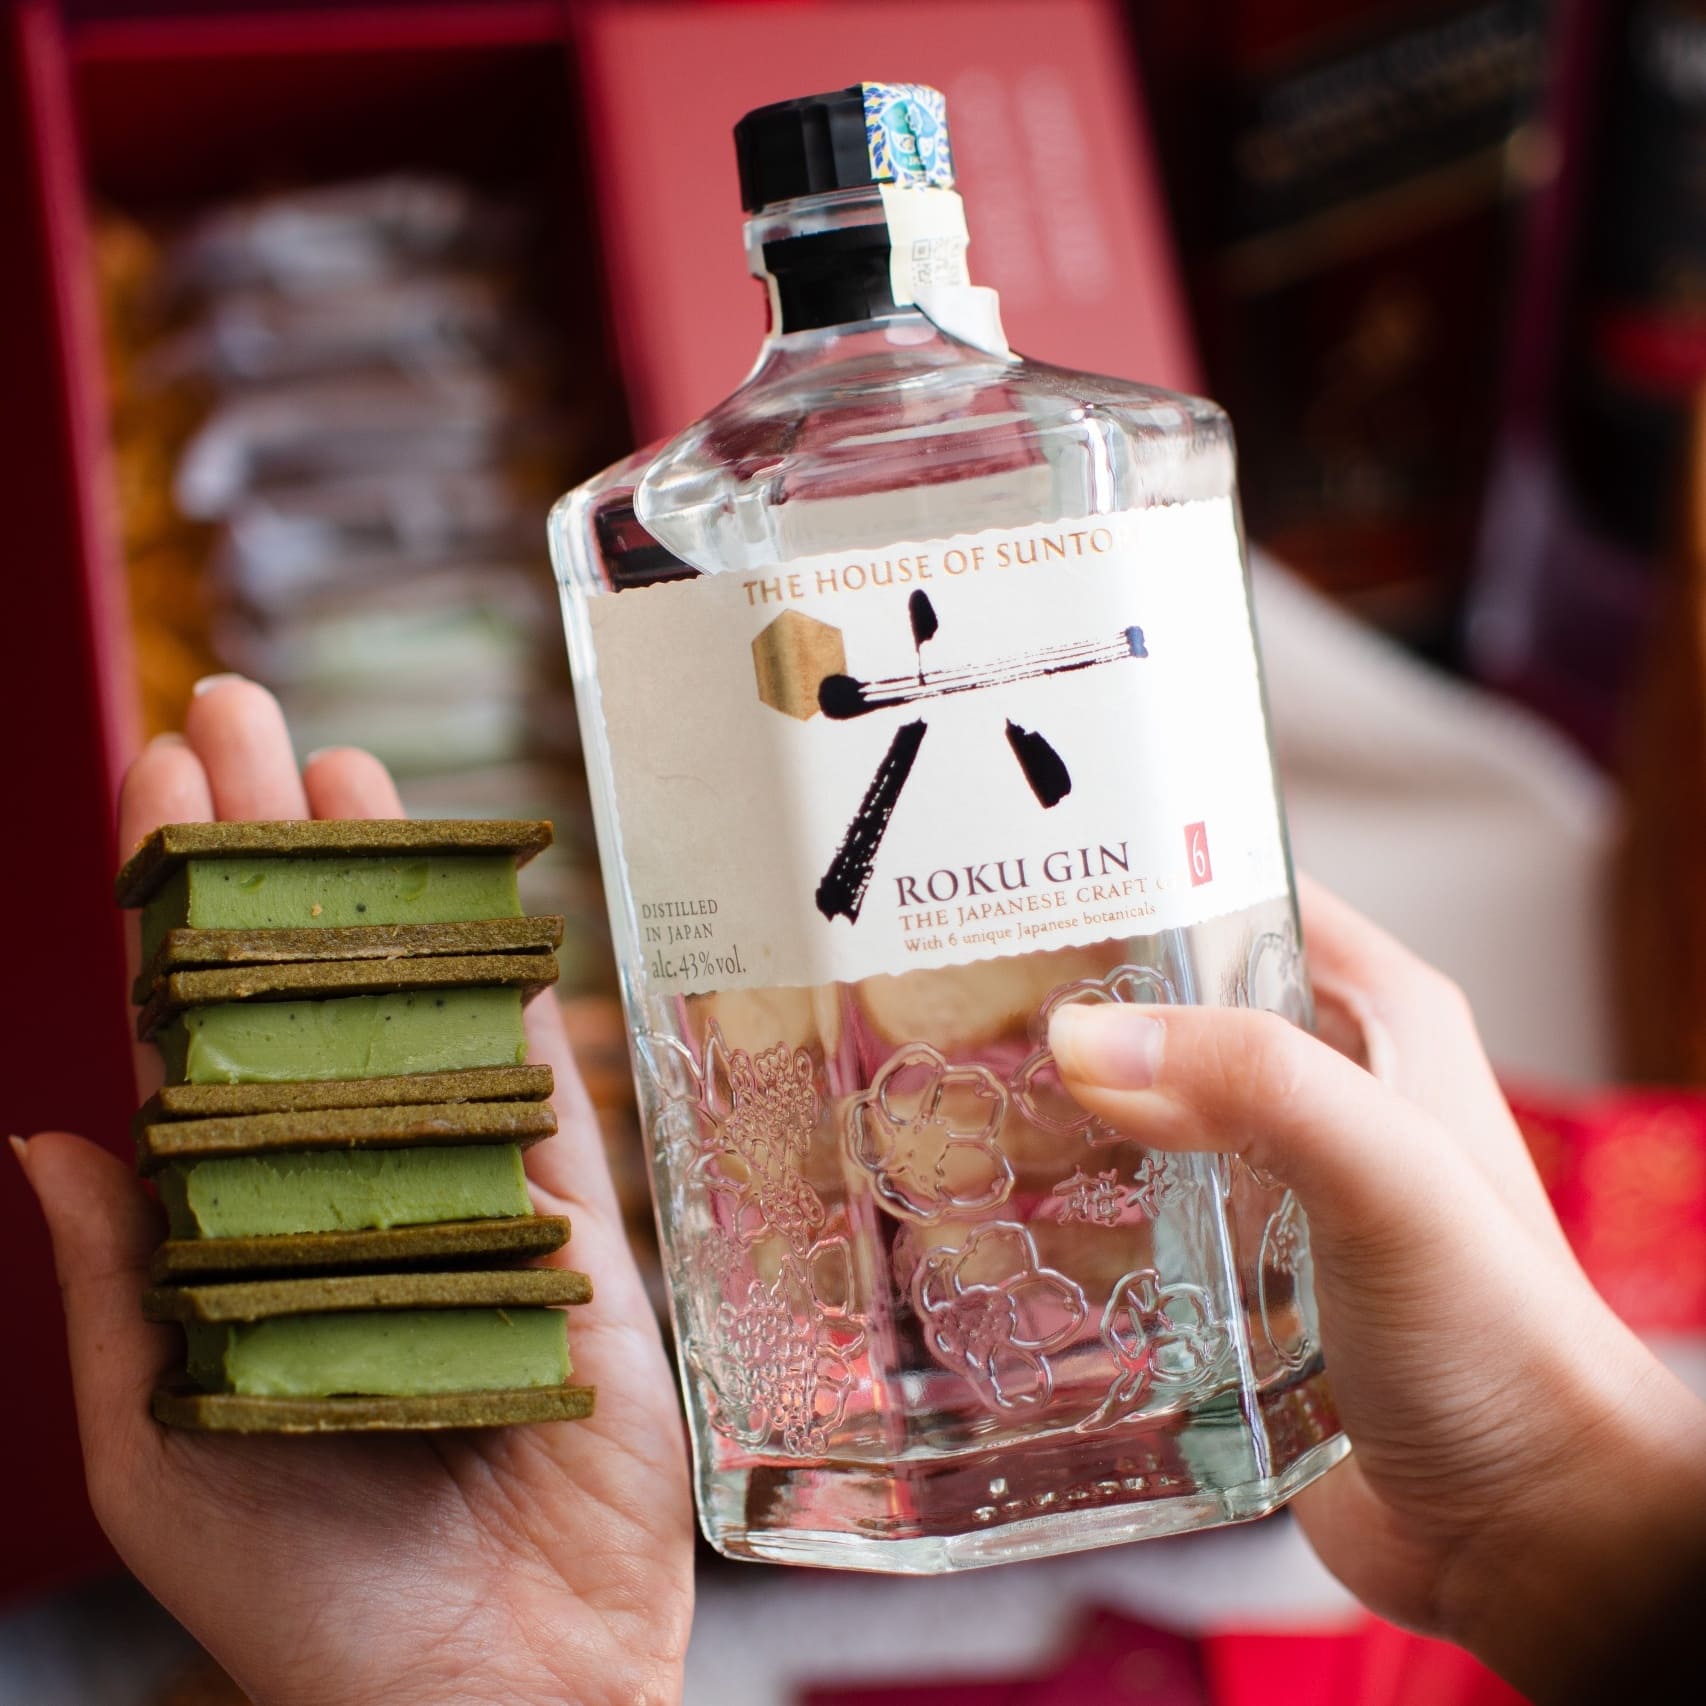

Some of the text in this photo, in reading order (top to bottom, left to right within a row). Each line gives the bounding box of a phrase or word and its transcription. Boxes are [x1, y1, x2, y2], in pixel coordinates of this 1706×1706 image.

[743, 527, 1122, 606] THE HOUSE OF SUNTO
[894, 841, 1132, 907] ROKU GIN
[1191, 830, 1206, 878] 6
[641, 899, 718, 919] DISTILLED
[899, 909, 949, 931] THE
[957, 890, 1068, 927] JAPANESE
[1076, 877, 1148, 902] CRAFT
[904, 902, 1157, 953] With 6 unique Japanese botanicals
[646, 923, 714, 944] IN JAPAN
